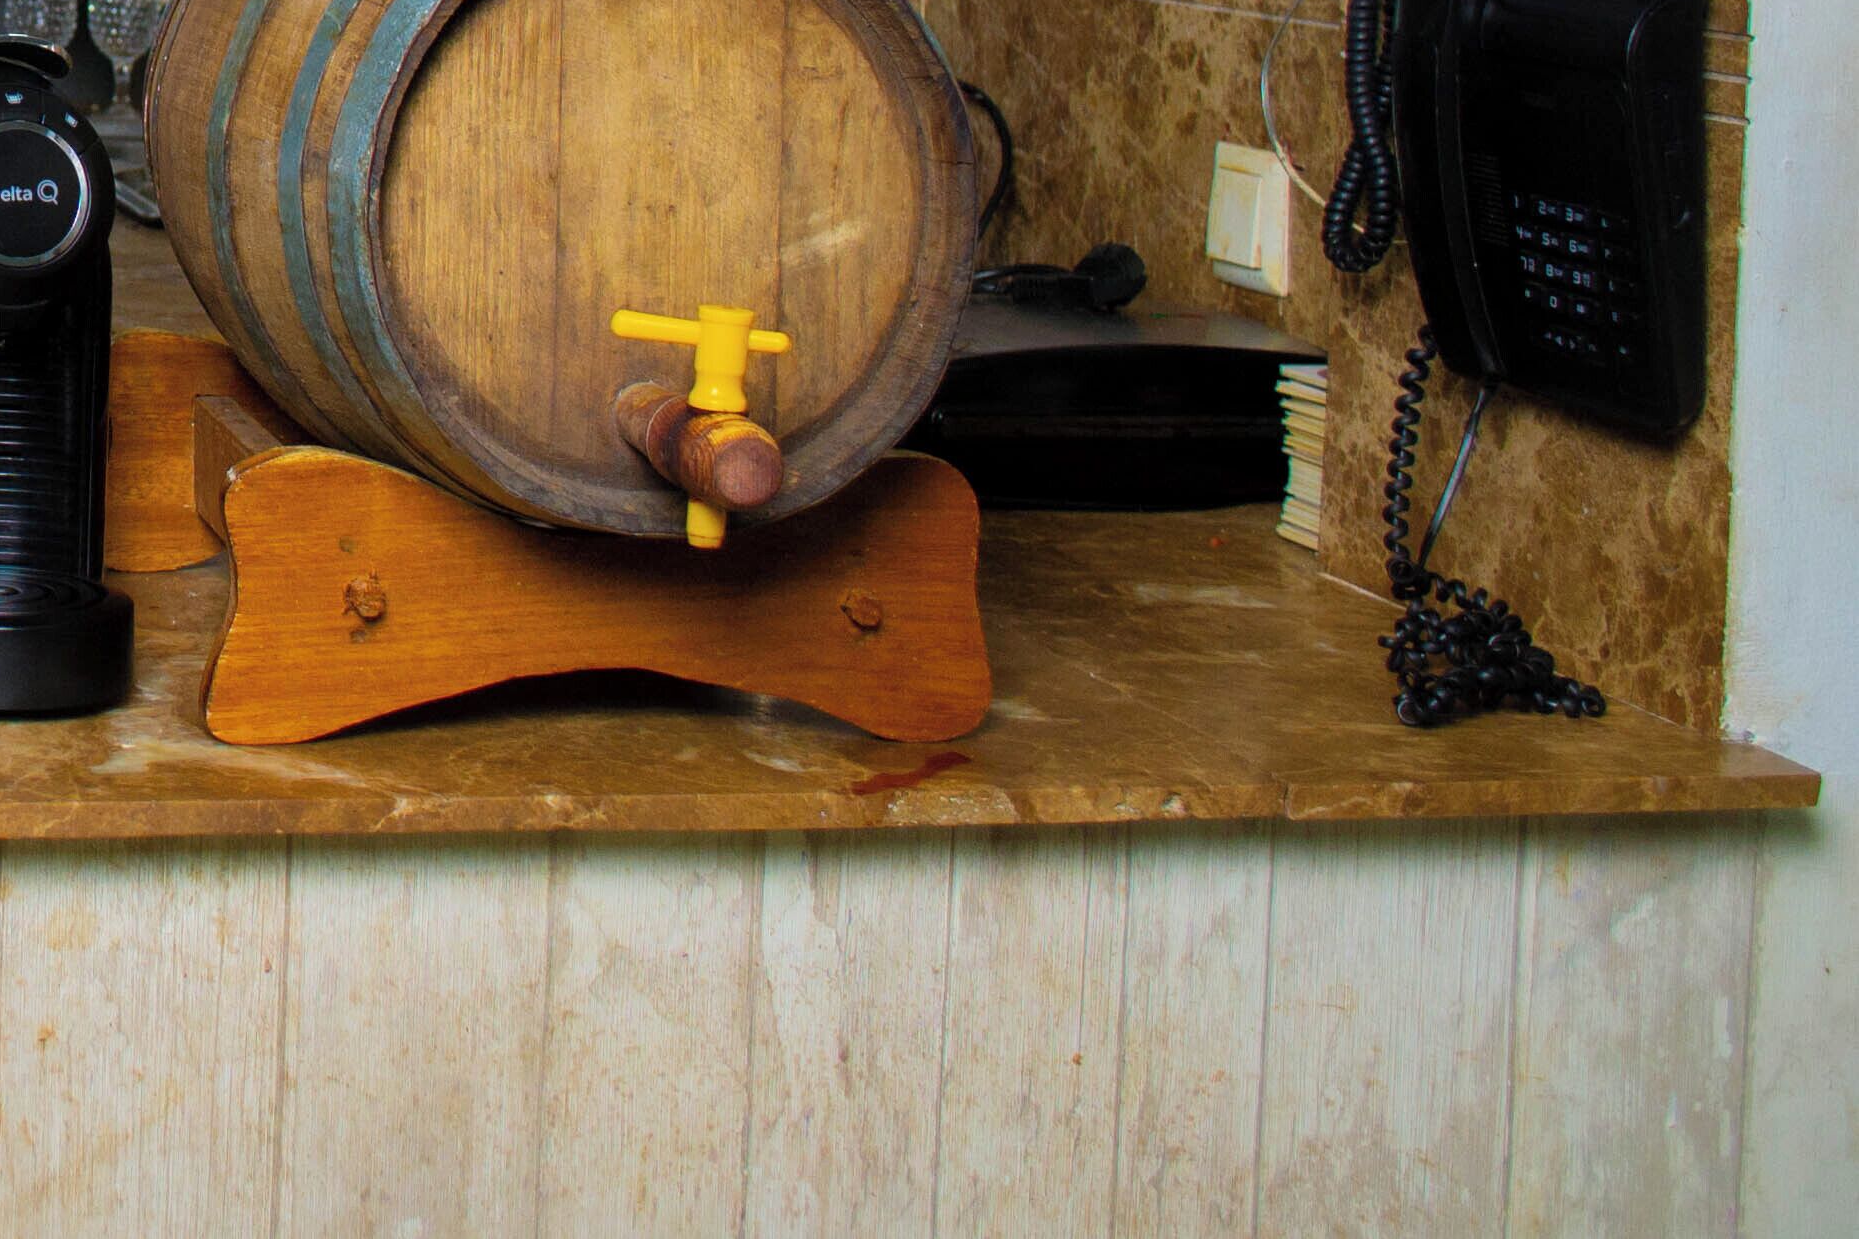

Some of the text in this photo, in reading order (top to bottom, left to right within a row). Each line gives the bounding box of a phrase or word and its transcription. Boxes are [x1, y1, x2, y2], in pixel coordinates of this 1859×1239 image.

[37, 179, 59, 205] Q
[1541, 232, 1550, 247] 5
[1569, 239, 1578, 254] 6
